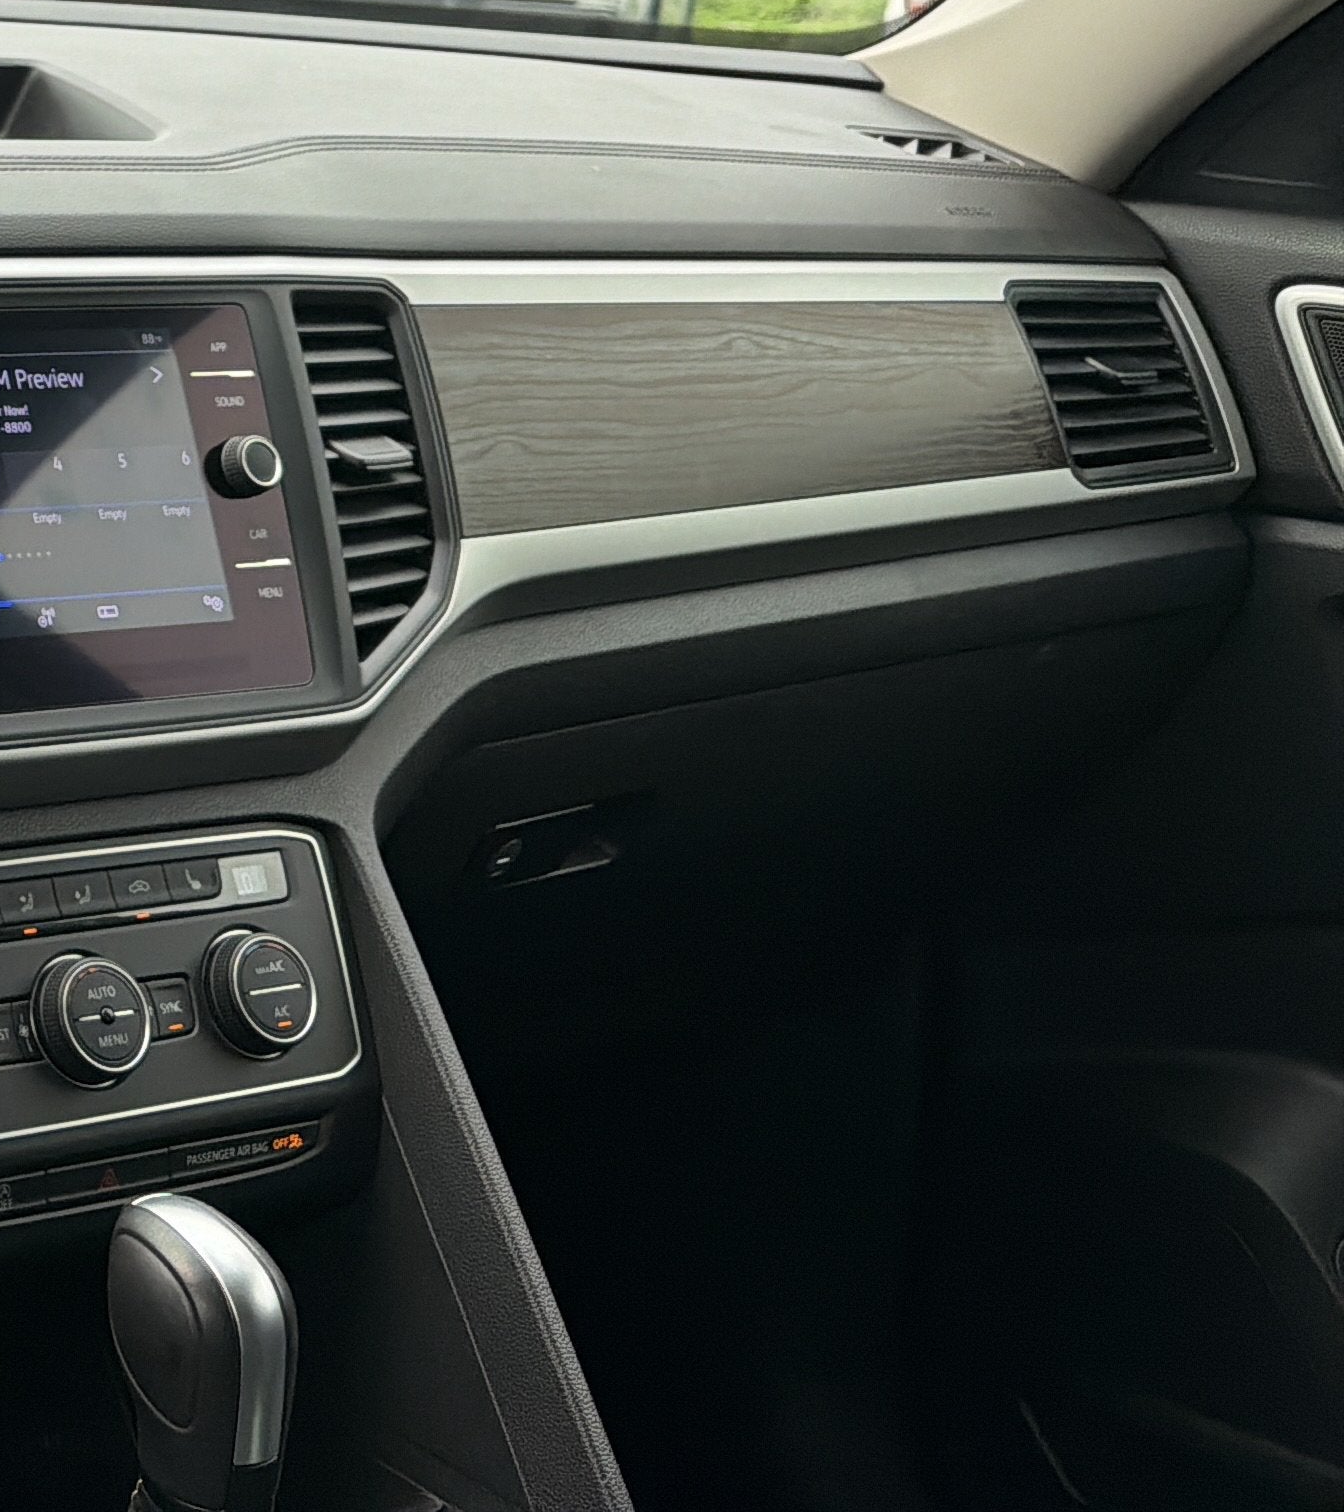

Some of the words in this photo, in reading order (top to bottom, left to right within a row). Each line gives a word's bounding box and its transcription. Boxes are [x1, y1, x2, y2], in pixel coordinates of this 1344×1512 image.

[14, 368, 84, 390] Preview
[214, 395, 245, 407] SOUND
[53, 456, 63, 471] 4
[118, 452, 128, 469] 5
[181, 450, 192, 466] 6
[33, 511, 62, 525] Empty
[98, 508, 128, 521] Empty
[162, 504, 191, 518] Empty
[249, 528, 267, 539] CAR
[258, 587, 283, 598] MENU
[87, 985, 116, 1000] AUTO
[160, 1001, 183, 1014] SYNC
[99, 1033, 128, 1047] MENU
[186, 1148, 235, 1166] PASSENGER
[237, 1144, 250, 1156] AIR
[252, 1142, 269, 1154] BAG
[272, 1137, 289, 1150] OFF
